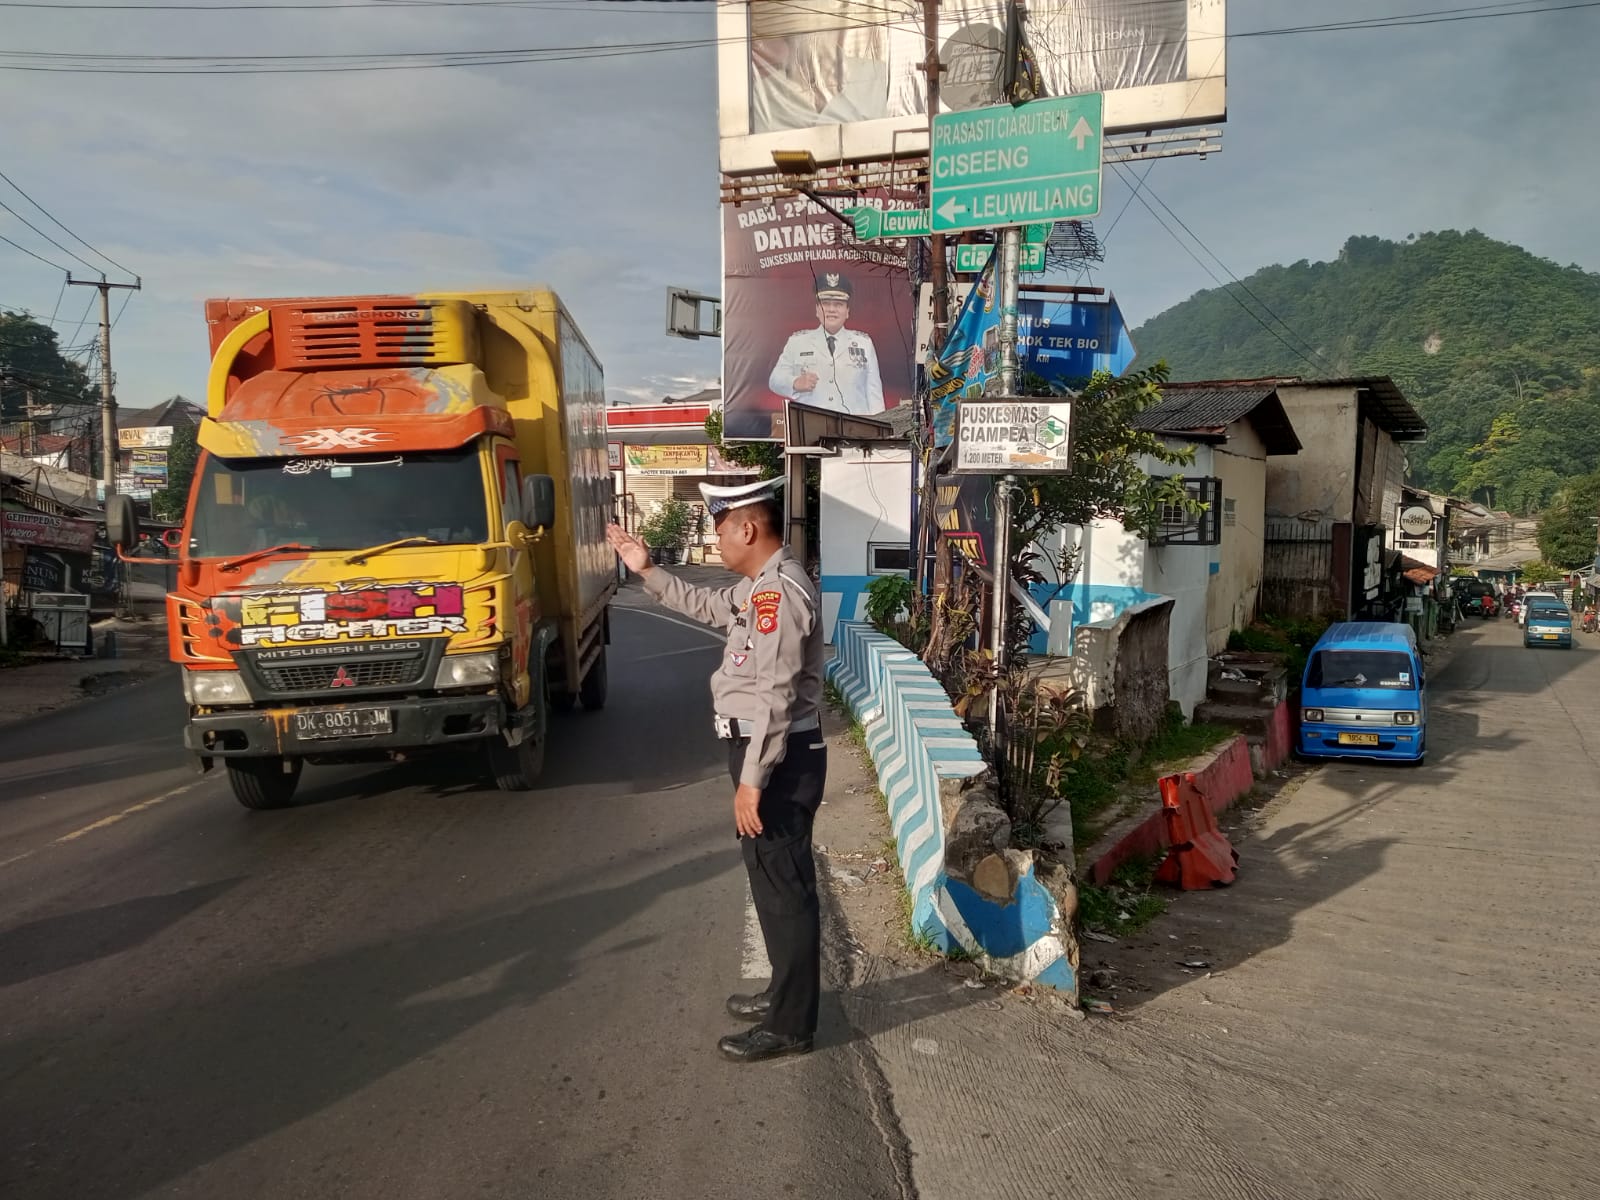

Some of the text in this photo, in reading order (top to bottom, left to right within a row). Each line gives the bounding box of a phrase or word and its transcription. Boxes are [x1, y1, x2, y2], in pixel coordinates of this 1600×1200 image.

[935, 109, 1069, 147] PRASASTI CIARUTEUN
[935, 146, 1029, 178] CISEENG
[972, 184, 1094, 219] LEUWILIANG
[883, 208, 930, 232] leuwil
[753, 223, 836, 253] DATANG
[759, 250, 804, 269] SUKSESKAN
[805, 249, 837, 261] PILKADA
[1049, 336, 1074, 349] TEK
[1077, 338, 1099, 350] BIO
[1036, 353, 1050, 363] KM
[961, 406, 1039, 424] PUSKESMAS
[960, 426, 1030, 442] CIAMPEA
[981, 452, 1003, 465] METER
[31, 515, 62, 528] PEDAS
[4, 527, 38, 538] WARKOP
[240, 584, 464, 626] FISH
[240, 616, 468, 646] FIGHTER
[257, 641, 421, 659] MITSUBISHI FUSO
[297, 715, 317, 730] DK
[325, 711, 359, 728] 8051
